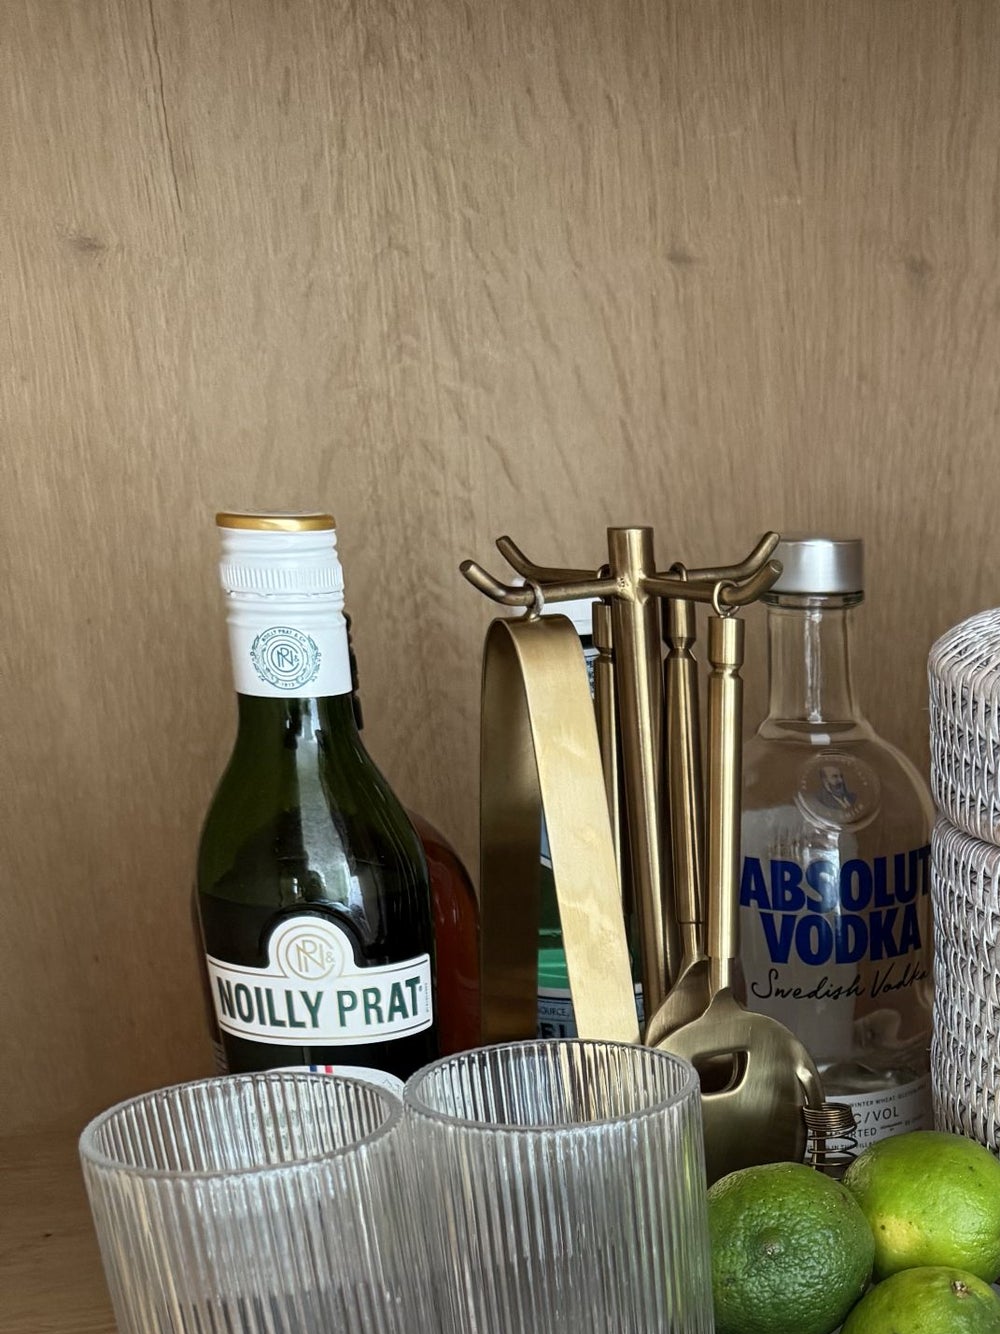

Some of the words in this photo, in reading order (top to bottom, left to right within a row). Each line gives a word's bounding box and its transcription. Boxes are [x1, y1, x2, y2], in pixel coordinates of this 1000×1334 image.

[739, 844, 932, 913] ABSOLUT
[760, 904, 922, 966] VODKA
[217, 976, 324, 1029] NOILLY
[336, 976, 421, 1028] PRAT
[751, 968, 866, 1000] Swedish
[870, 962, 930, 999] Vodka
